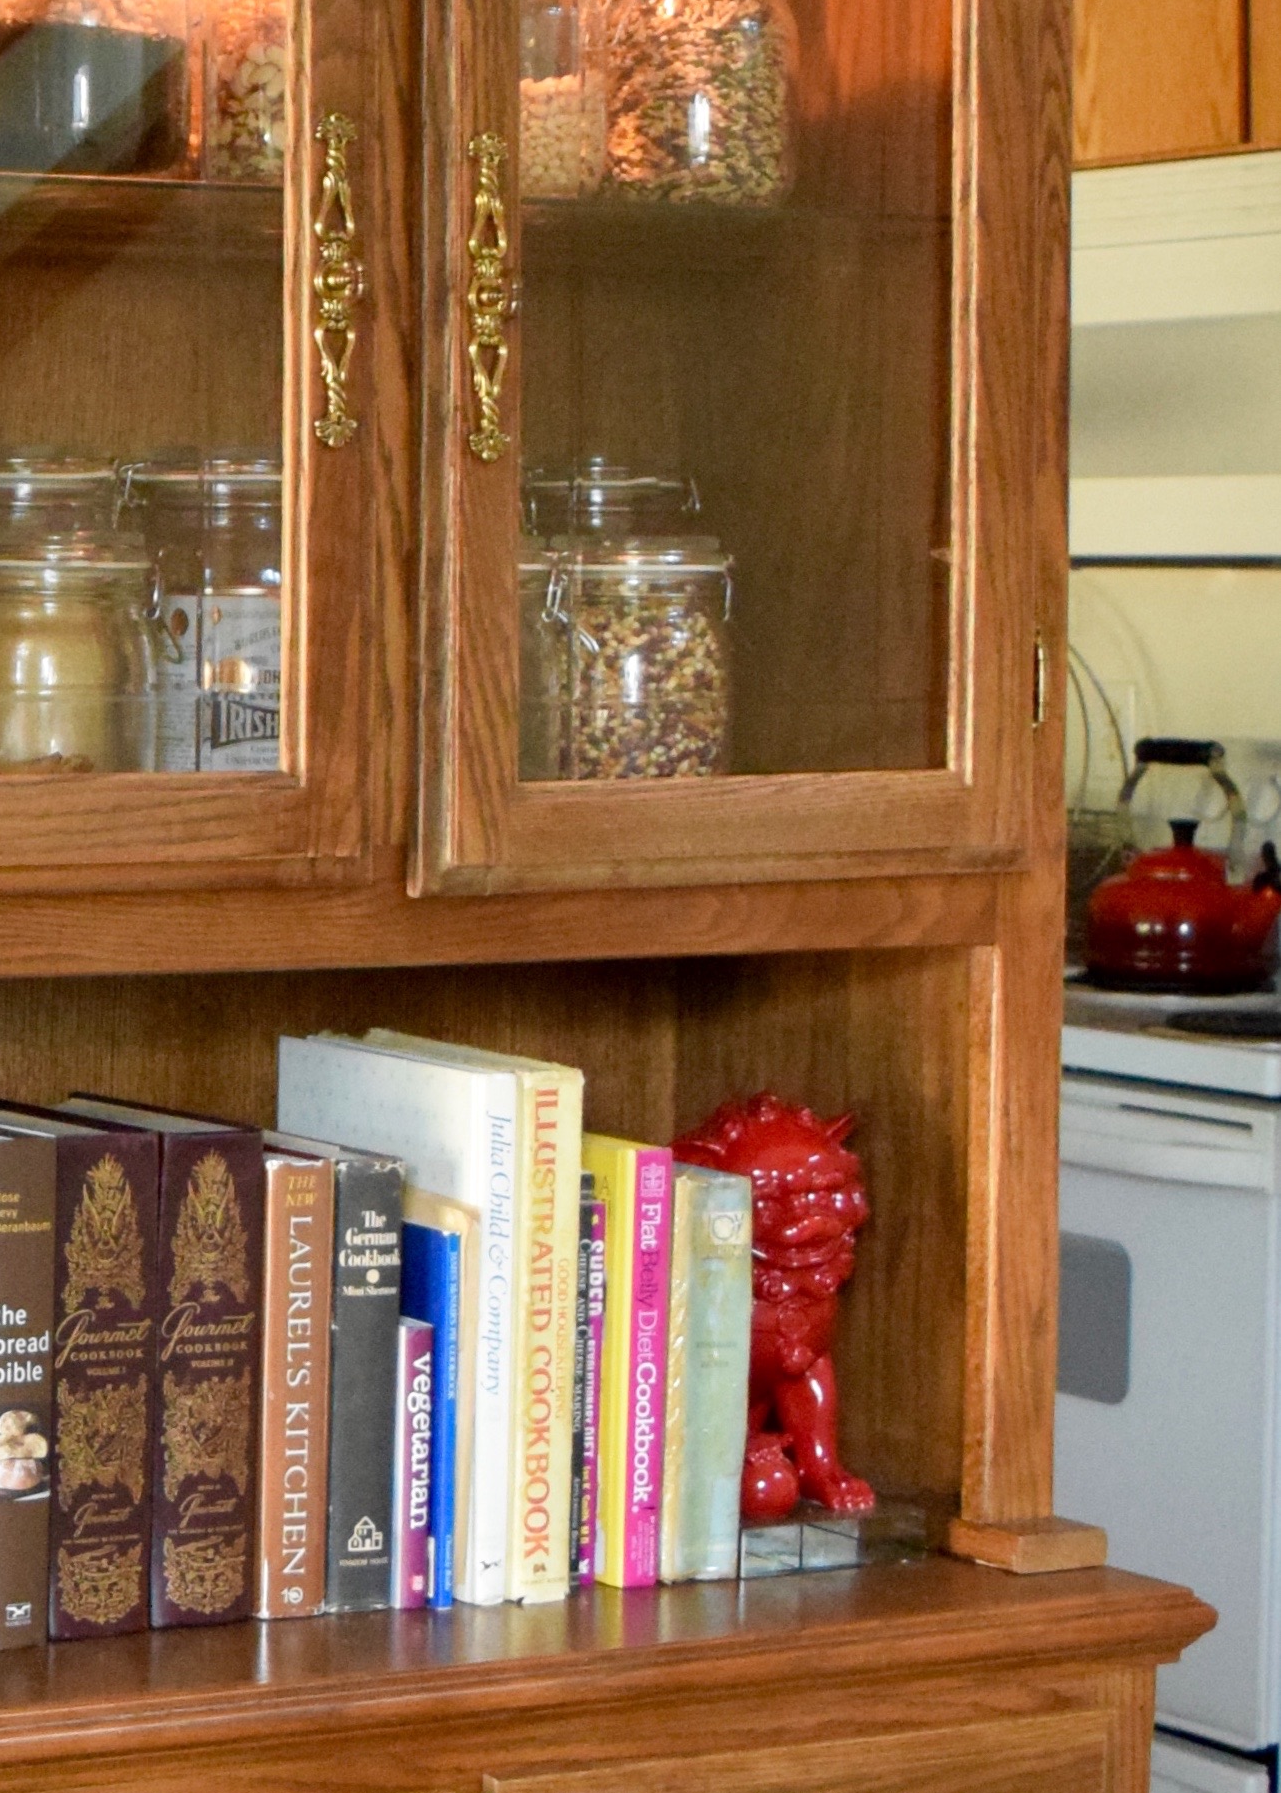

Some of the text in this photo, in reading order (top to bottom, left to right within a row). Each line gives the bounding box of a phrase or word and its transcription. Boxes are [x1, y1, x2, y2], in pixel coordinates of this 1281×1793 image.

[219, 693, 279, 743] IRISH
[487, 1111, 512, 1166] Julia
[286, 1192, 317, 1206] NEW
[288, 1175, 317, 1190] THE
[489, 1172, 511, 1238] Child
[362, 1210, 387, 1229] The
[530, 1088, 559, 1332] ILLUSTRATED
[641, 1202, 661, 1250] Flat
[338, 1247, 401, 1267] Cookbook
[345, 1227, 398, 1246] German
[558, 1258, 570, 1301] GOOD
[55, 1309, 152, 1368] Gourmet
[70, 1348, 144, 1361] COOKBOOK
[161, 1302, 256, 1361] Gourmet
[175, 1341, 248, 1354] COOKBOOK
[480, 1275, 508, 1395] Company
[282, 1215, 313, 1575] LAUREL'S KITCHEN
[407, 1351, 431, 1529] vegetarian
[523, 1345, 552, 1560] COOKBOOK
